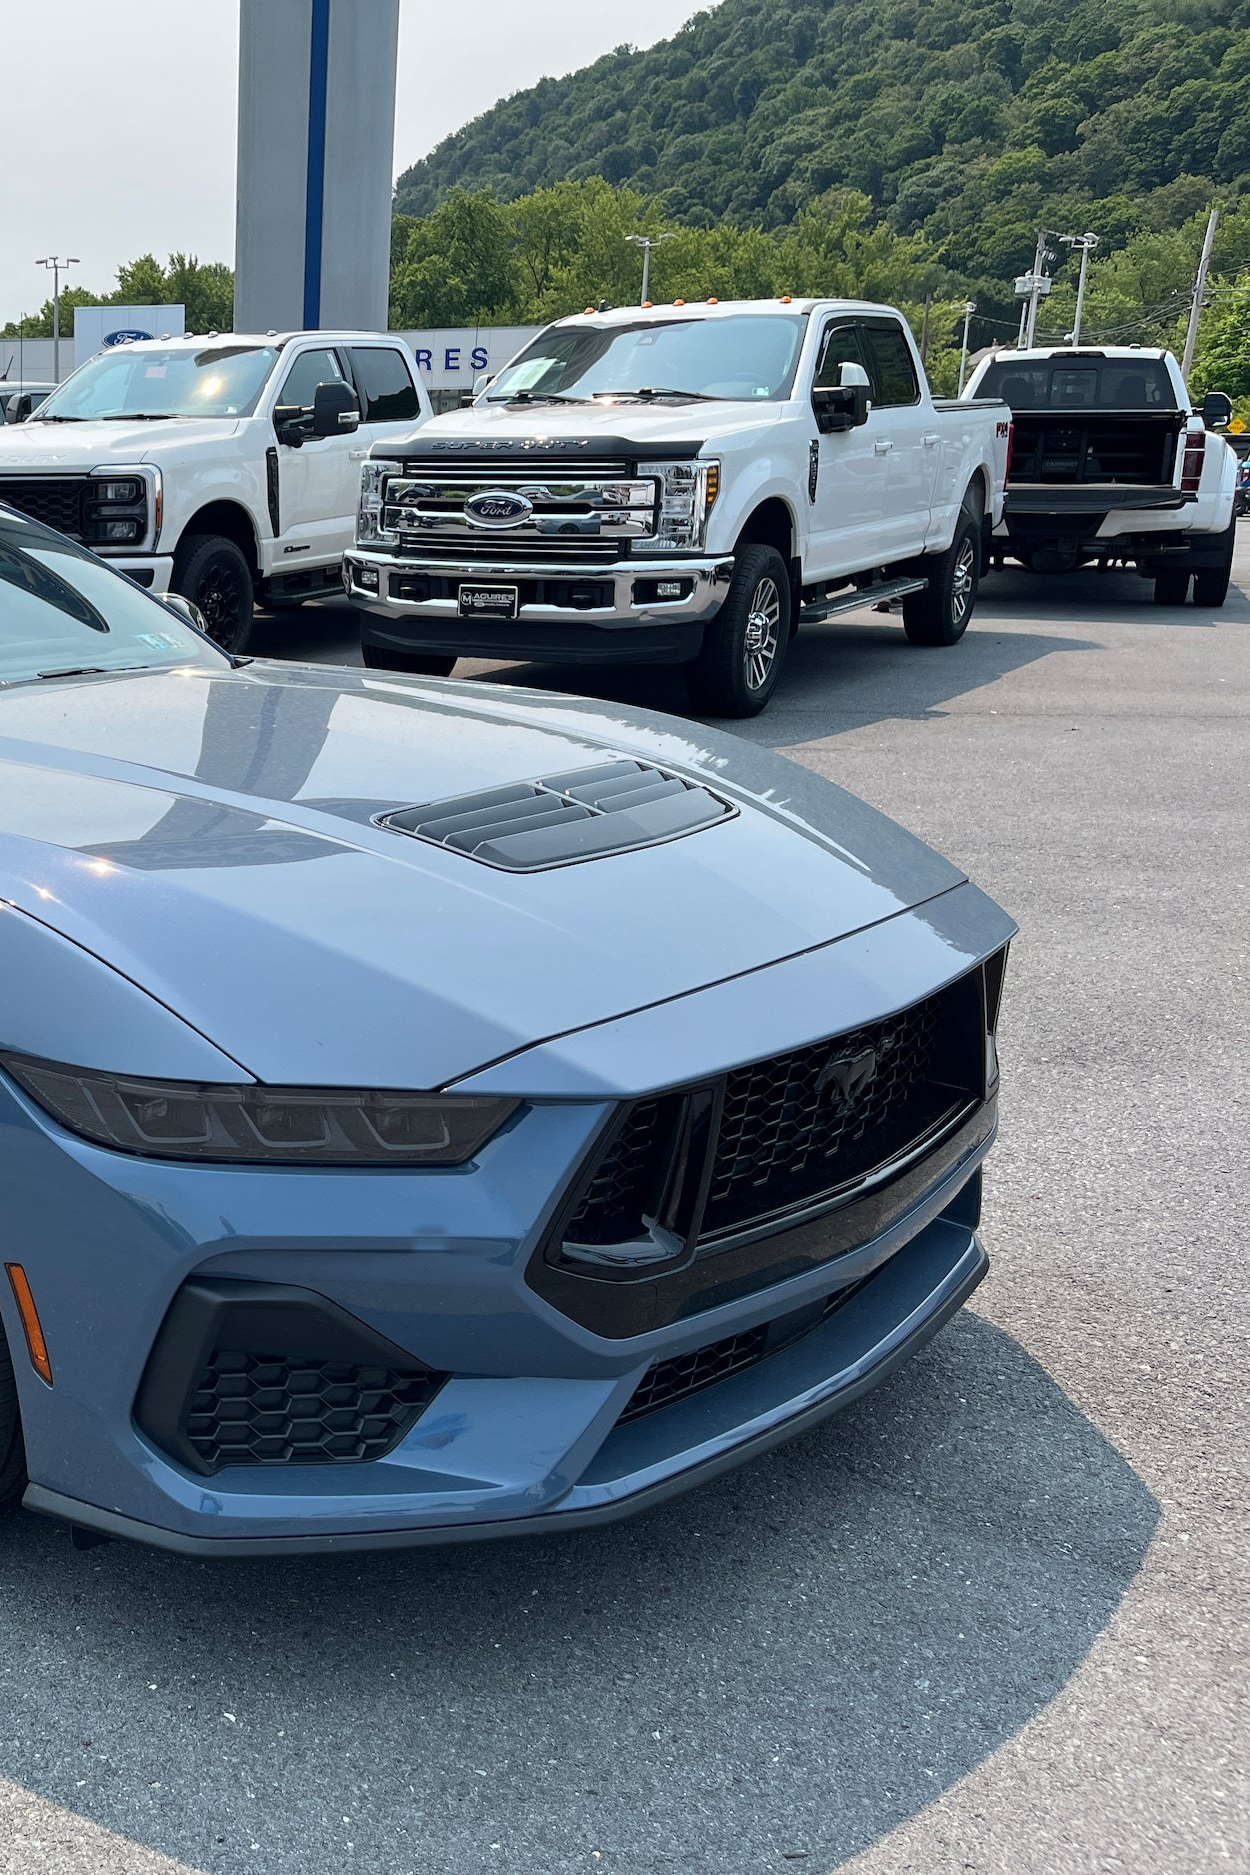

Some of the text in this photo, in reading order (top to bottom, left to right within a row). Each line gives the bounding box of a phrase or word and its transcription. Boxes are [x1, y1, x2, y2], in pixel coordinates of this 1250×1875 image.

[415, 347, 488, 371] RES
[431, 440, 590, 450] SUPER DUTY
[6, 454, 67, 463] DUTY
[480, 500, 513, 516] Ford
